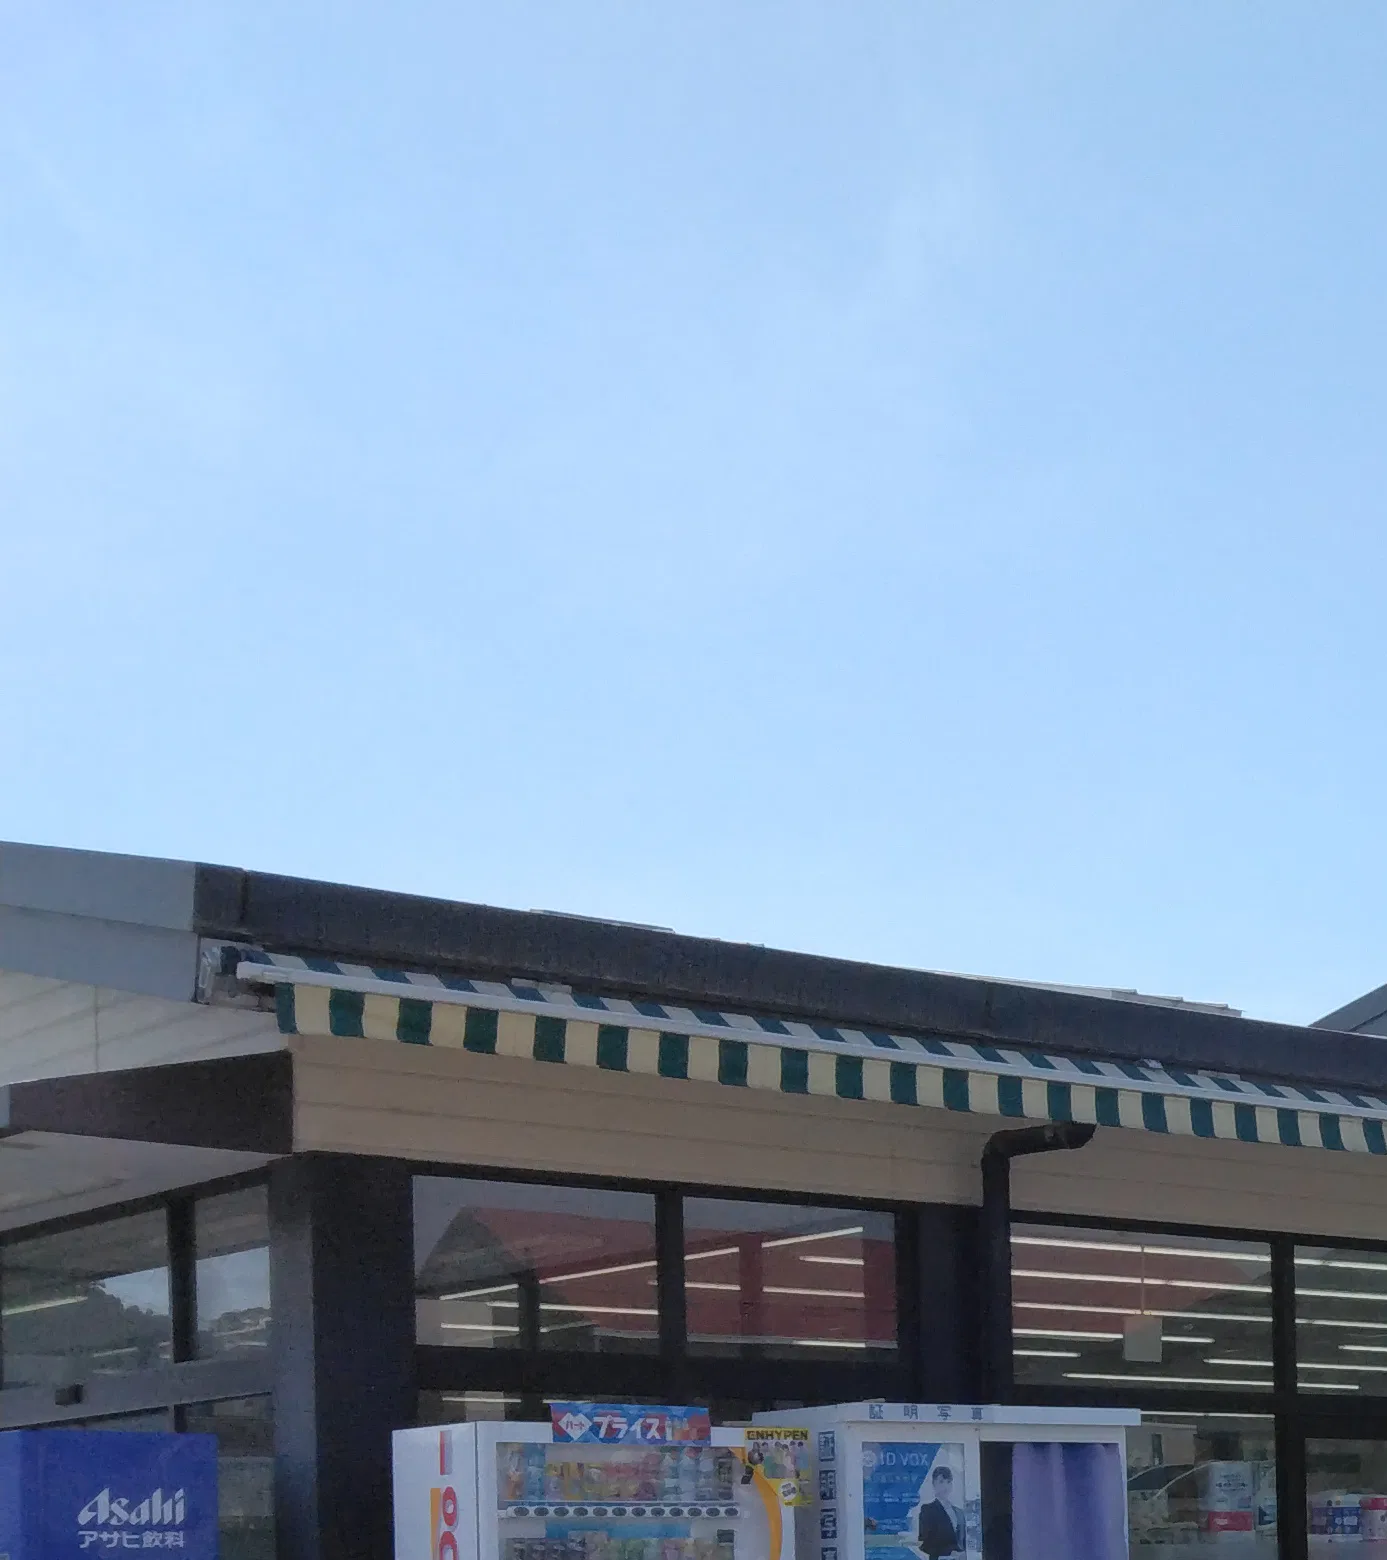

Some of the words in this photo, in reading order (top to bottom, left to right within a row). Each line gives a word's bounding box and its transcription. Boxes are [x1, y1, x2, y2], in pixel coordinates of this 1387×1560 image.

[593, 1414, 662, 1440] プライス
[746, 1430, 808, 1441] ENHYPEN
[78, 1487, 185, 1525] Asahi
[78, 1530, 184, 1549] アサヒ飲料
